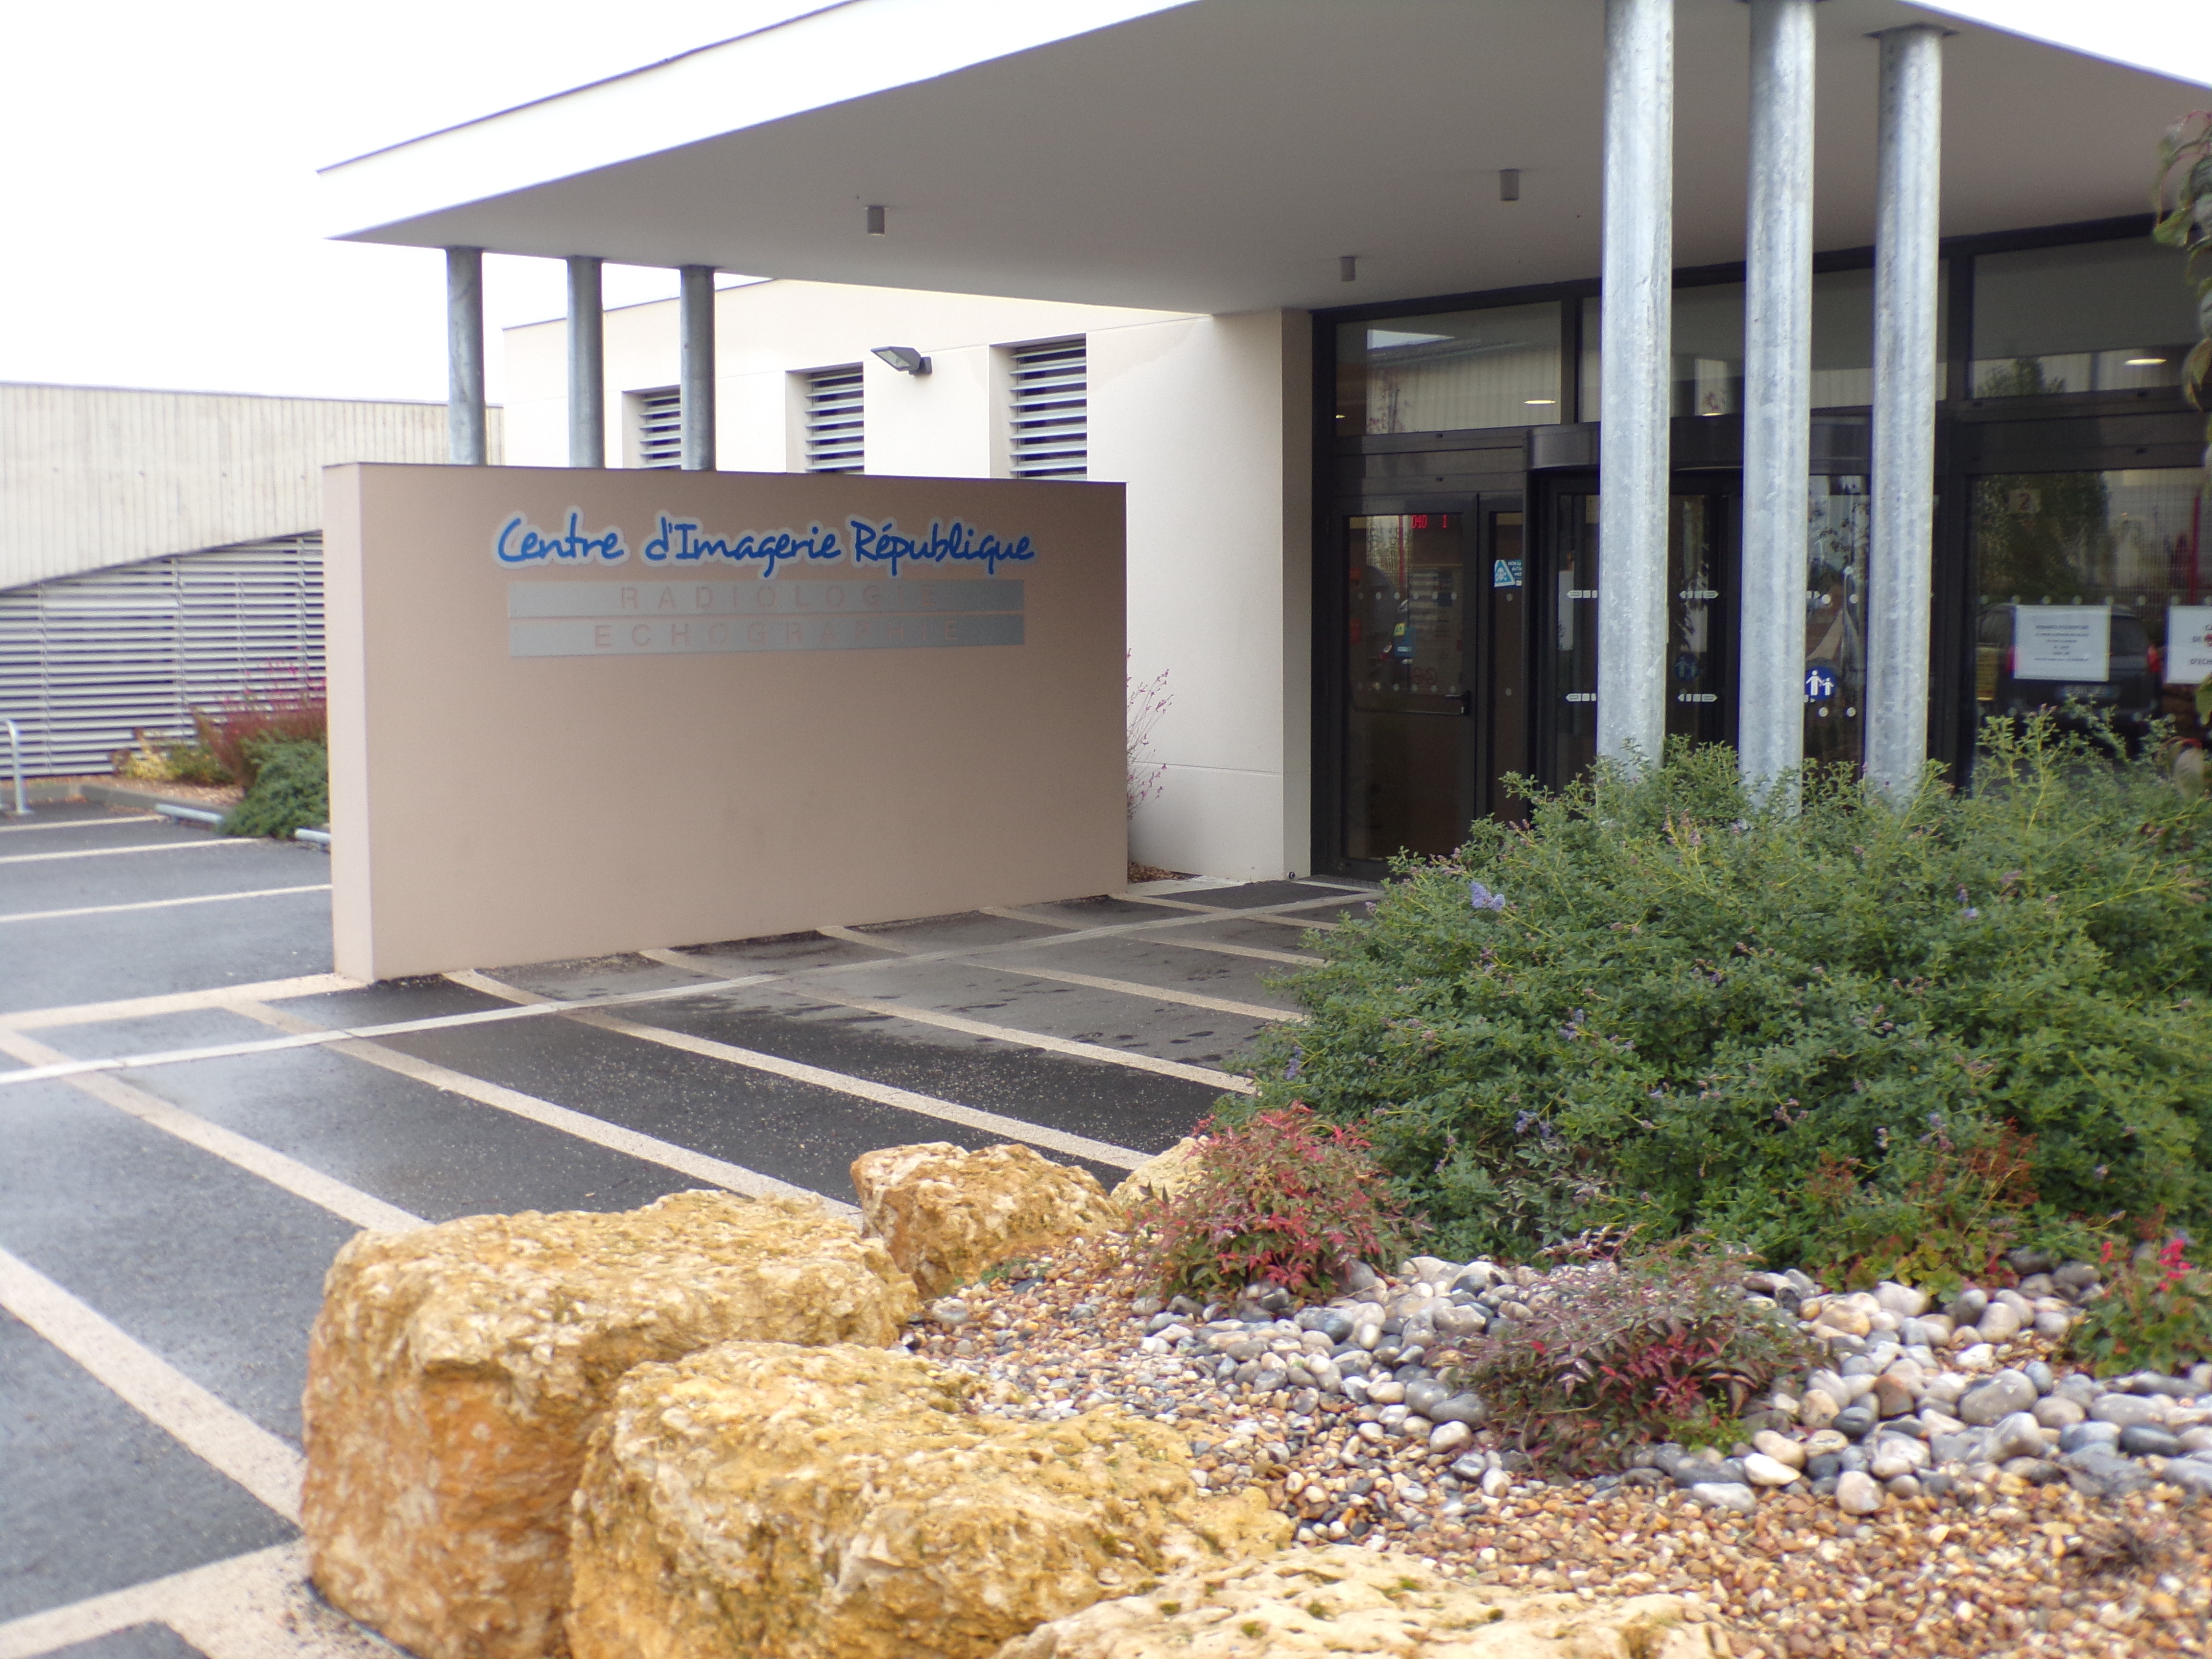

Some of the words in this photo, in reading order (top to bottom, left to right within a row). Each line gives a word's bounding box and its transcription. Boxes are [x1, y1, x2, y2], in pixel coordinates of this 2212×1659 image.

[498, 512, 625, 563] Centre
[645, 516, 842, 578] d'Imagerie
[850, 520, 1035, 577] République
[621, 584, 936, 611] RADIOLOGIE
[594, 619, 958, 649] ECHOGRAPHIE
